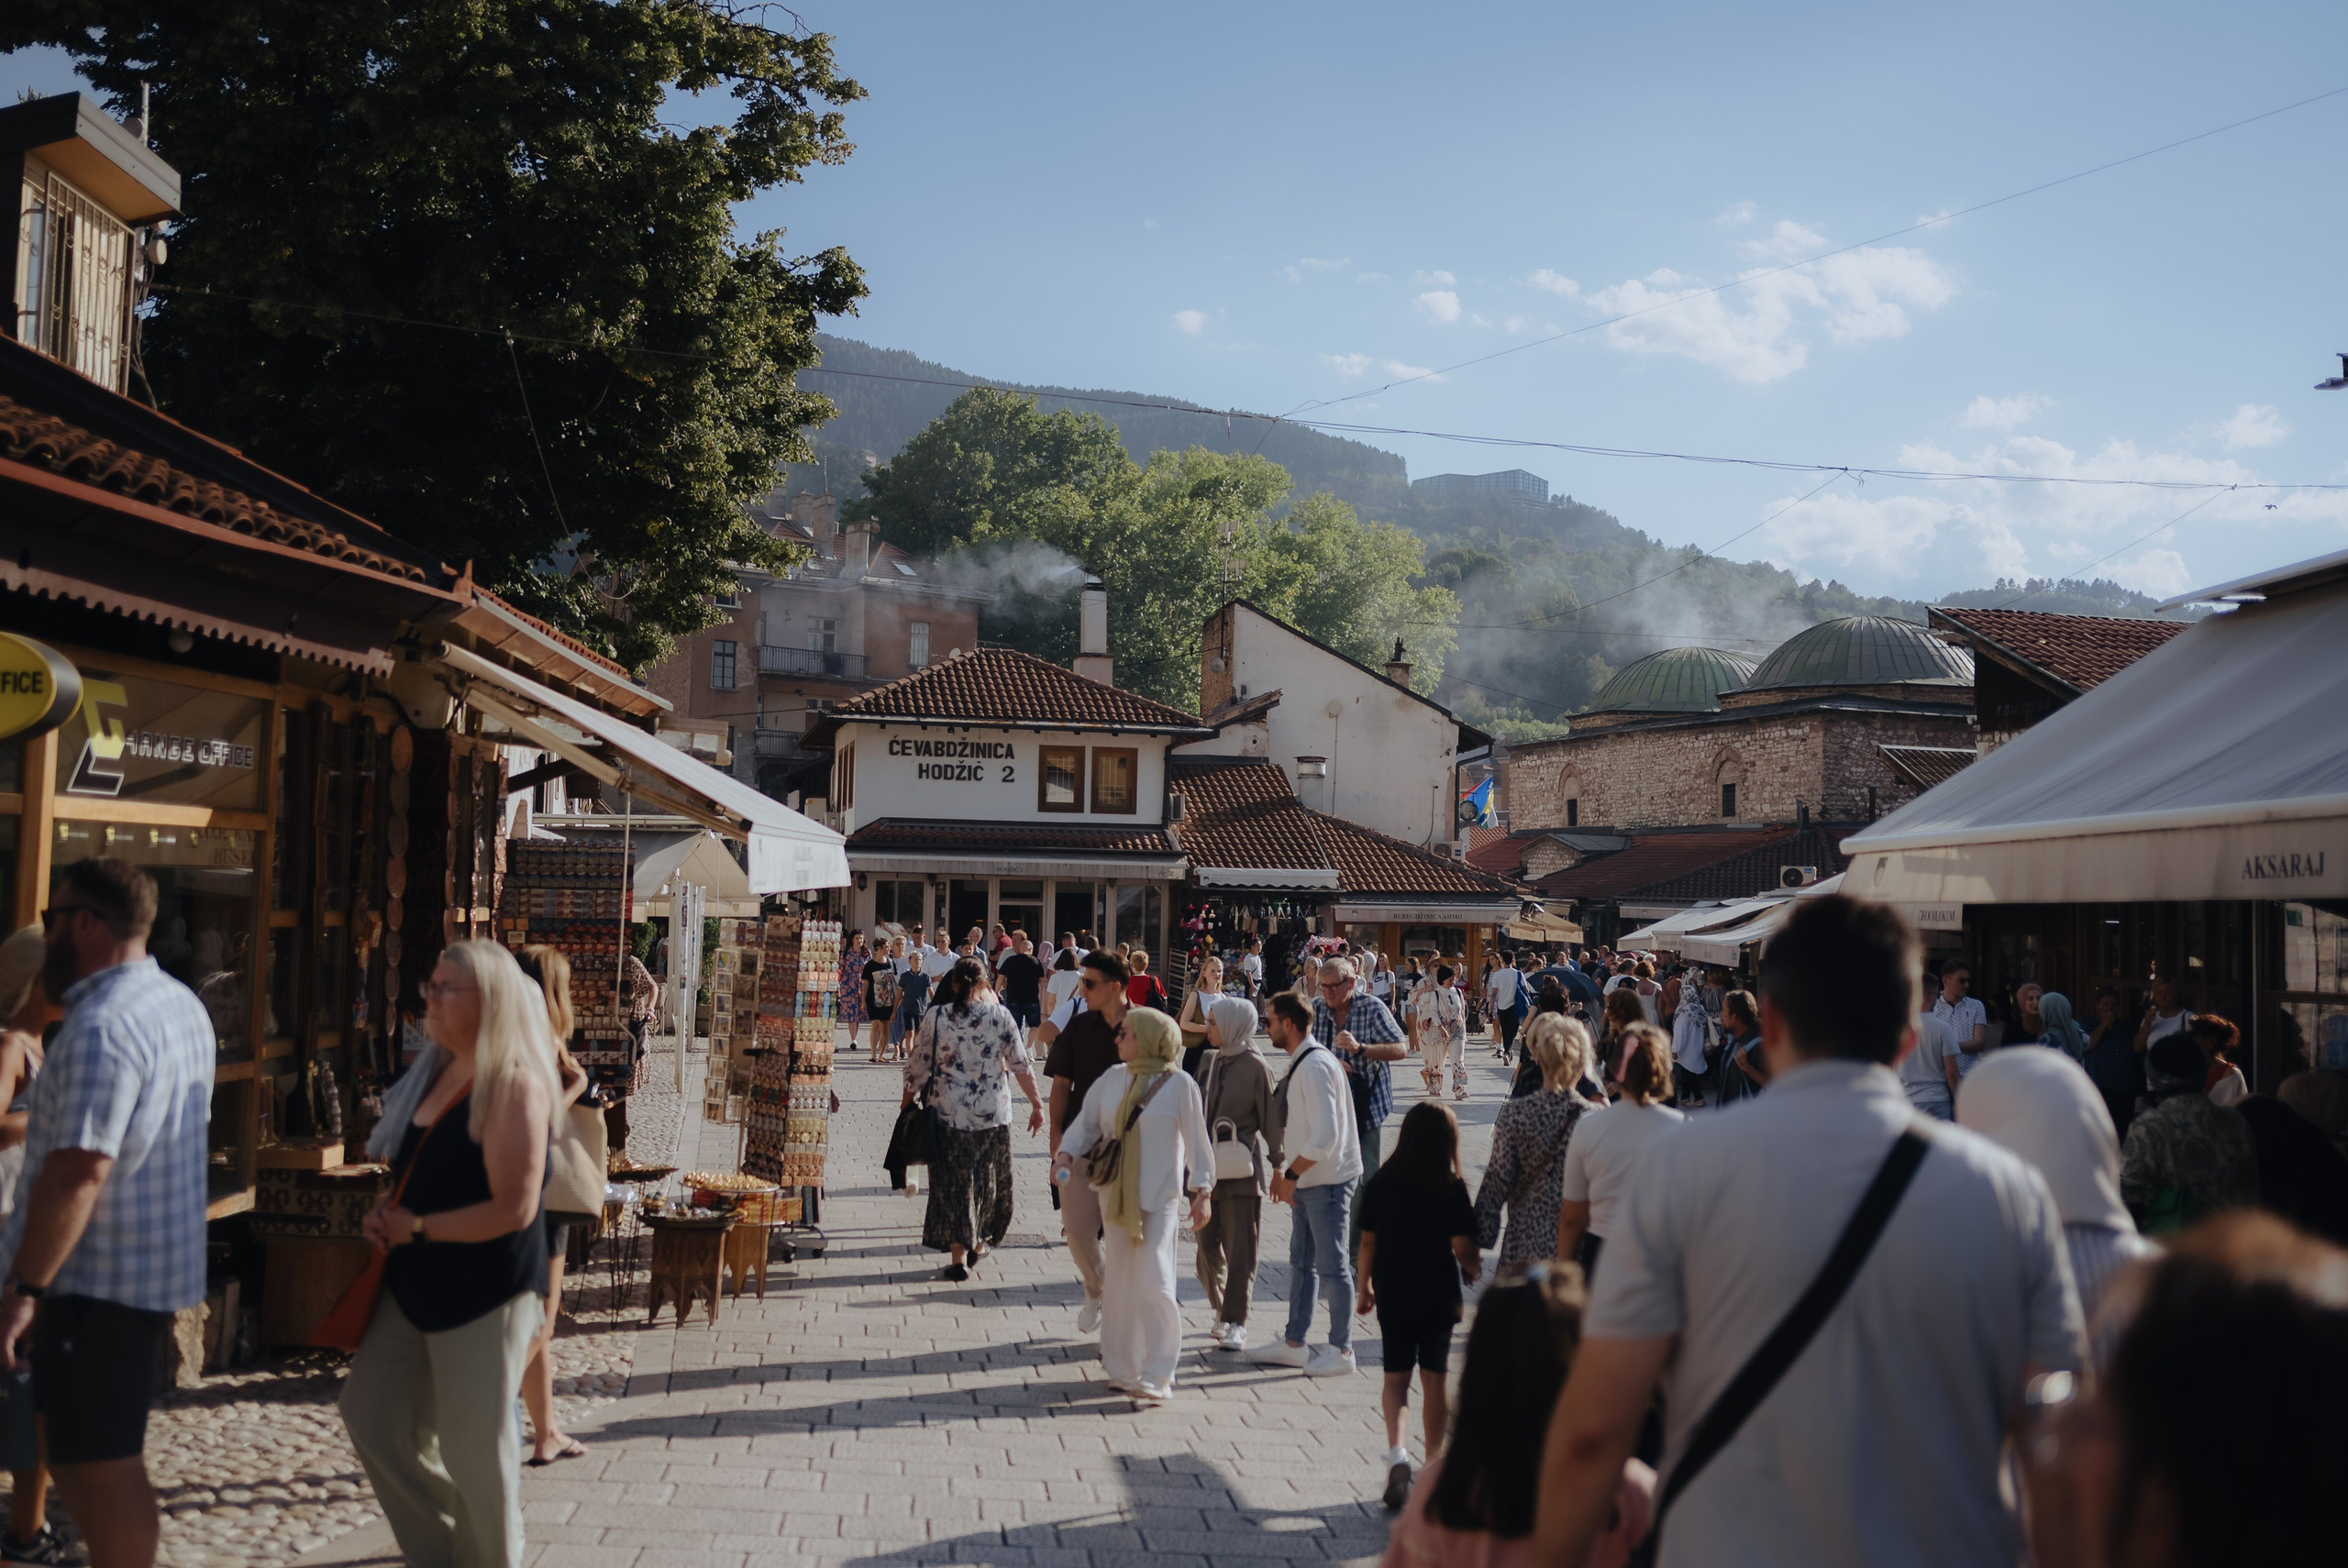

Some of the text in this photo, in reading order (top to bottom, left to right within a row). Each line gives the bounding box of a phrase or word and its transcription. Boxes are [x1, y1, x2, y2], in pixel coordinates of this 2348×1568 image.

[0, 670, 44, 694] FICE
[198, 740, 255, 769] OFFICE
[889, 734, 1015, 760] ĆEVABDŽINICA
[918, 760, 1015, 783] HODŽIĆ 2
[2242, 852, 2325, 879] AKSARAJ
